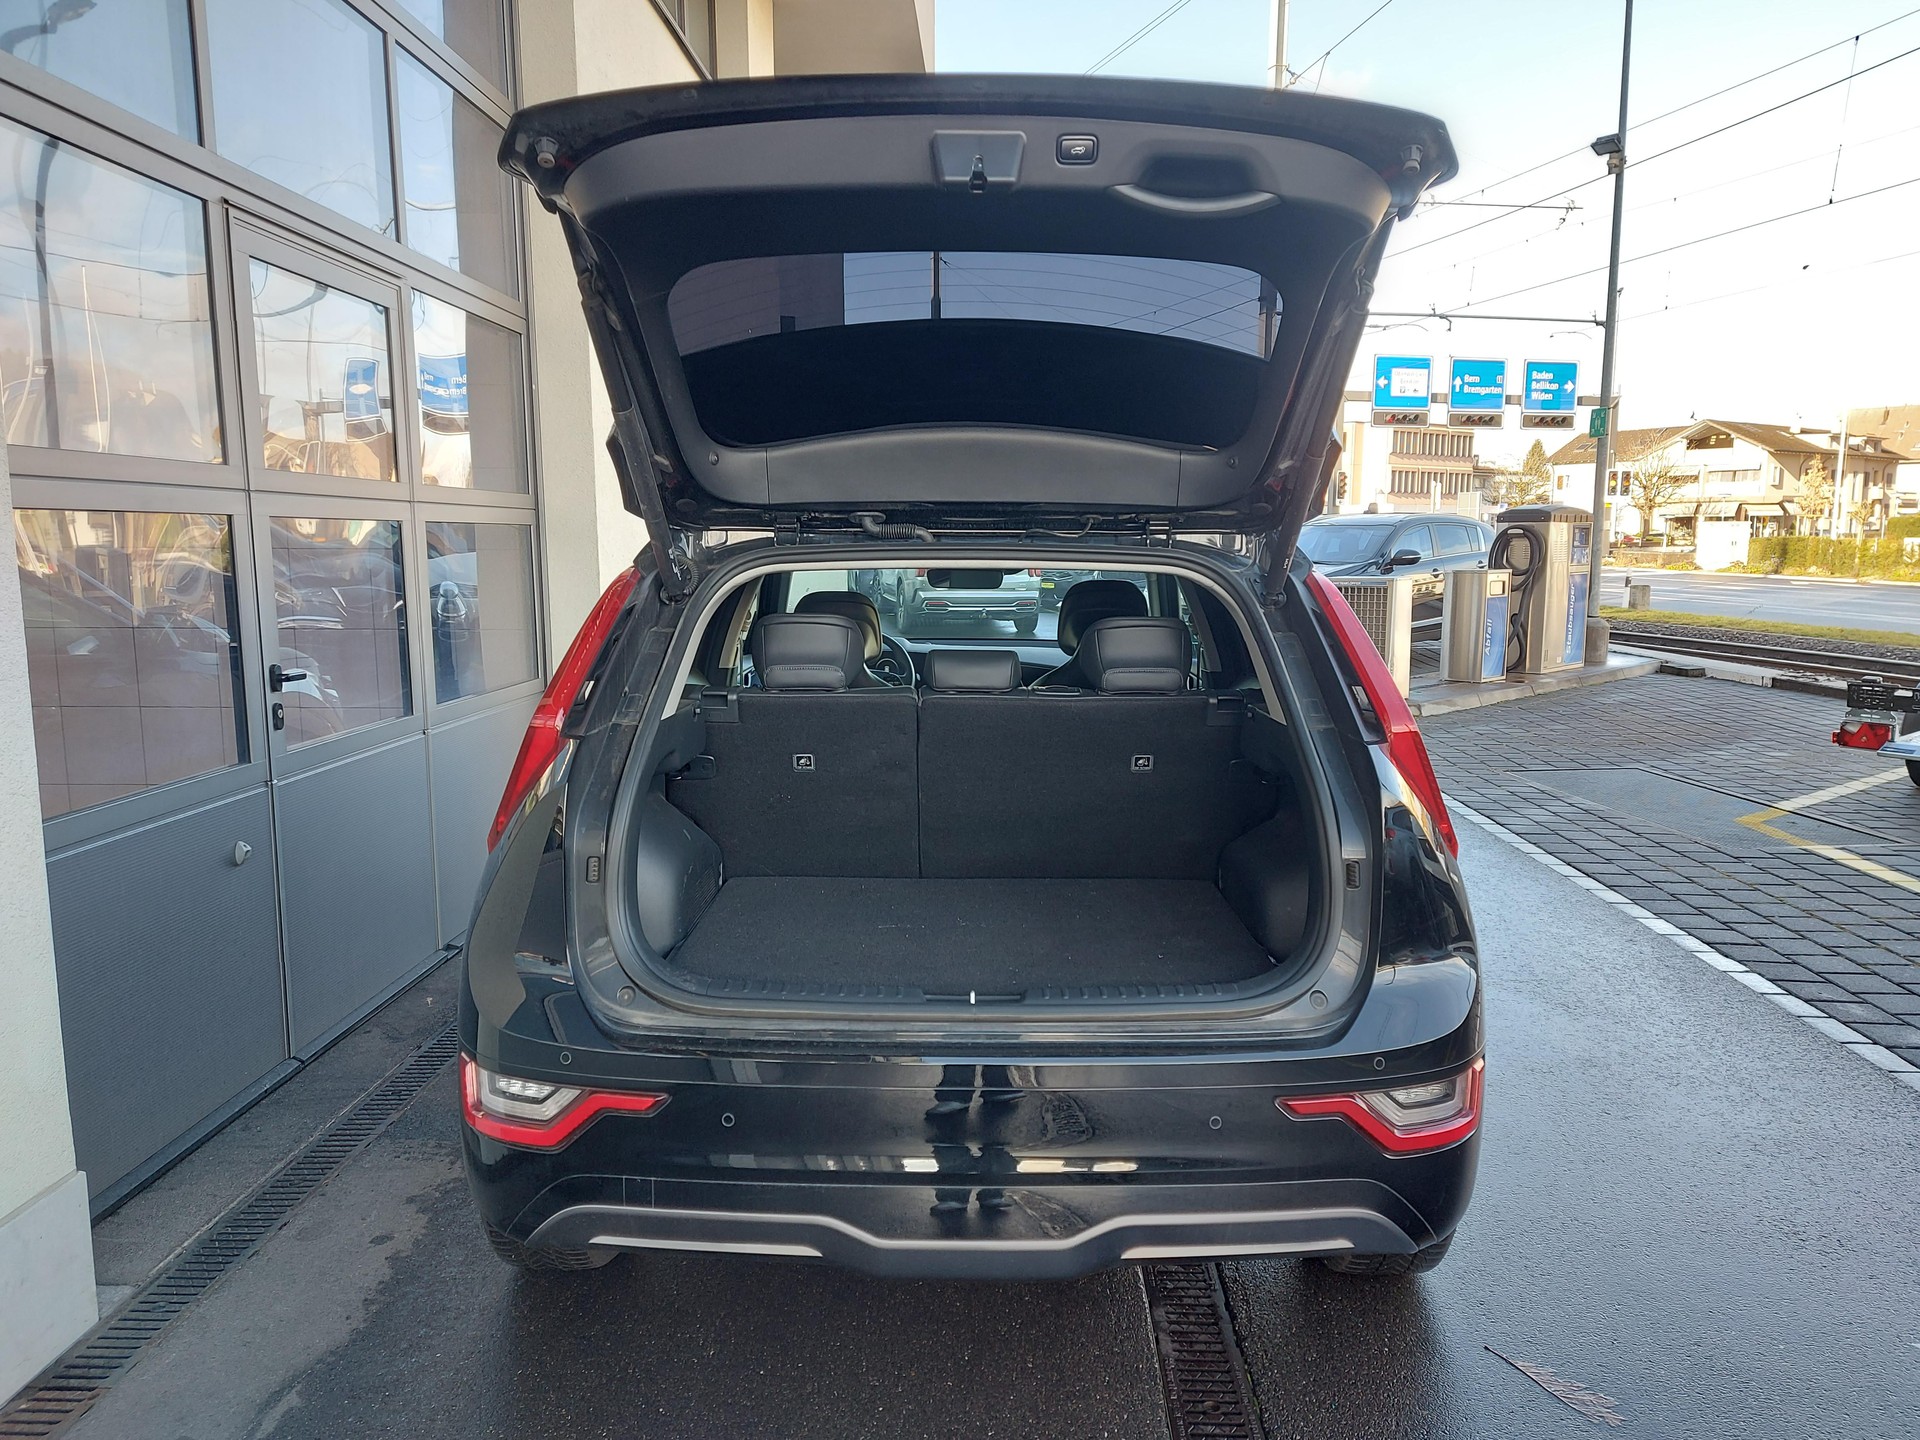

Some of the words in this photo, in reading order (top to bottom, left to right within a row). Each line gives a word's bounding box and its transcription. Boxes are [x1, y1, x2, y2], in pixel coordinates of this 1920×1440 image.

[1464, 374, 1480, 383] Bern
[1532, 371, 1554, 379] Baden
[1463, 384, 1503, 395] Bremgarten
[1531, 381, 1559, 390] Bellikon
[1531, 391, 1553, 400] Widen
[1566, 583, 1575, 654] Staubsauger
